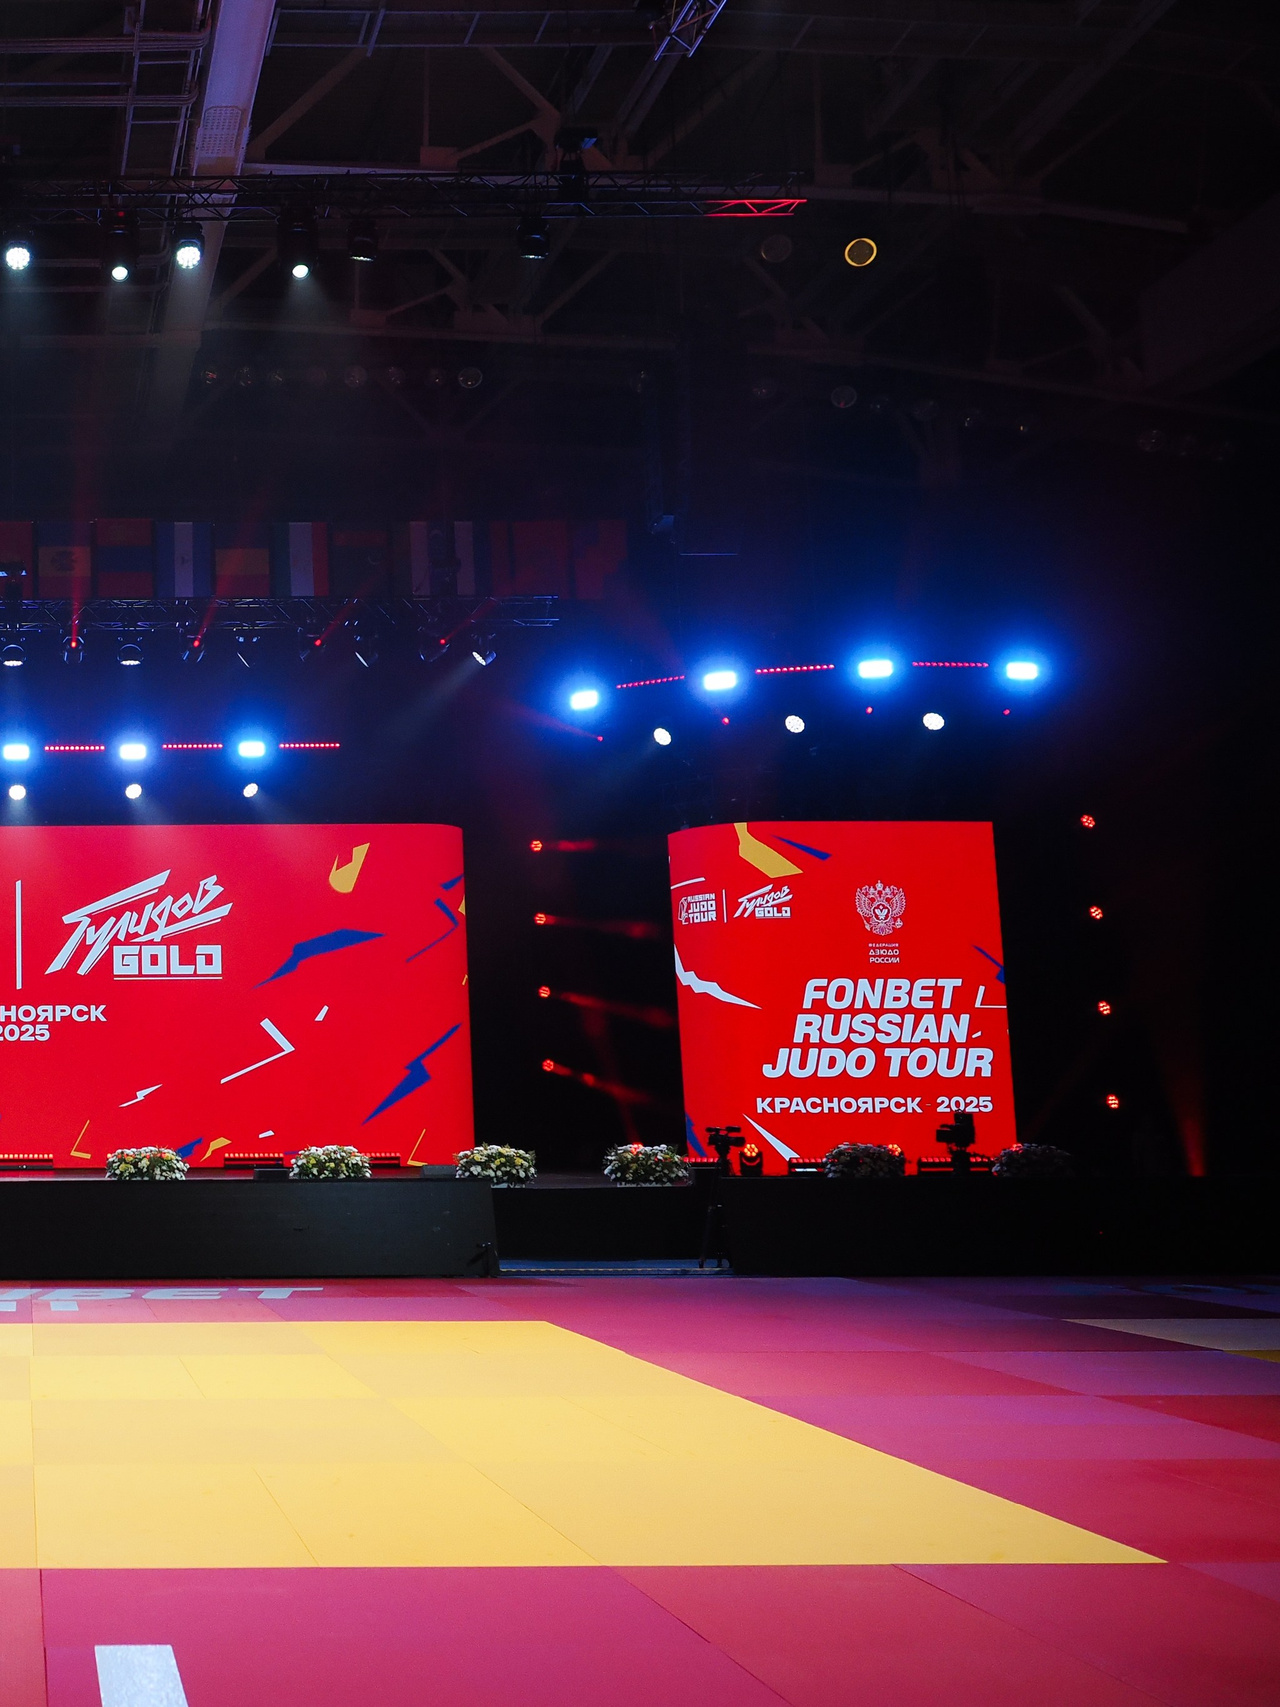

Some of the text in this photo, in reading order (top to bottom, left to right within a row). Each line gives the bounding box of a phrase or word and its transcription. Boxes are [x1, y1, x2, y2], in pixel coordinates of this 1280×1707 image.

[687, 893, 716, 903] RUSSIAN
[688, 900, 716, 913] JUDO
[688, 911, 717, 923] TOUR
[755, 906, 791, 917] GOLD
[113, 945, 222, 975] GOLD
[802, 978, 963, 1010] FONBET
[793, 1013, 970, 1043] RUSSIAN
[762, 1047, 994, 1079] JUDO TOUR
[756, 1097, 923, 1114] КРАСНОЯРСК
[936, 1096, 994, 1113] 2025
